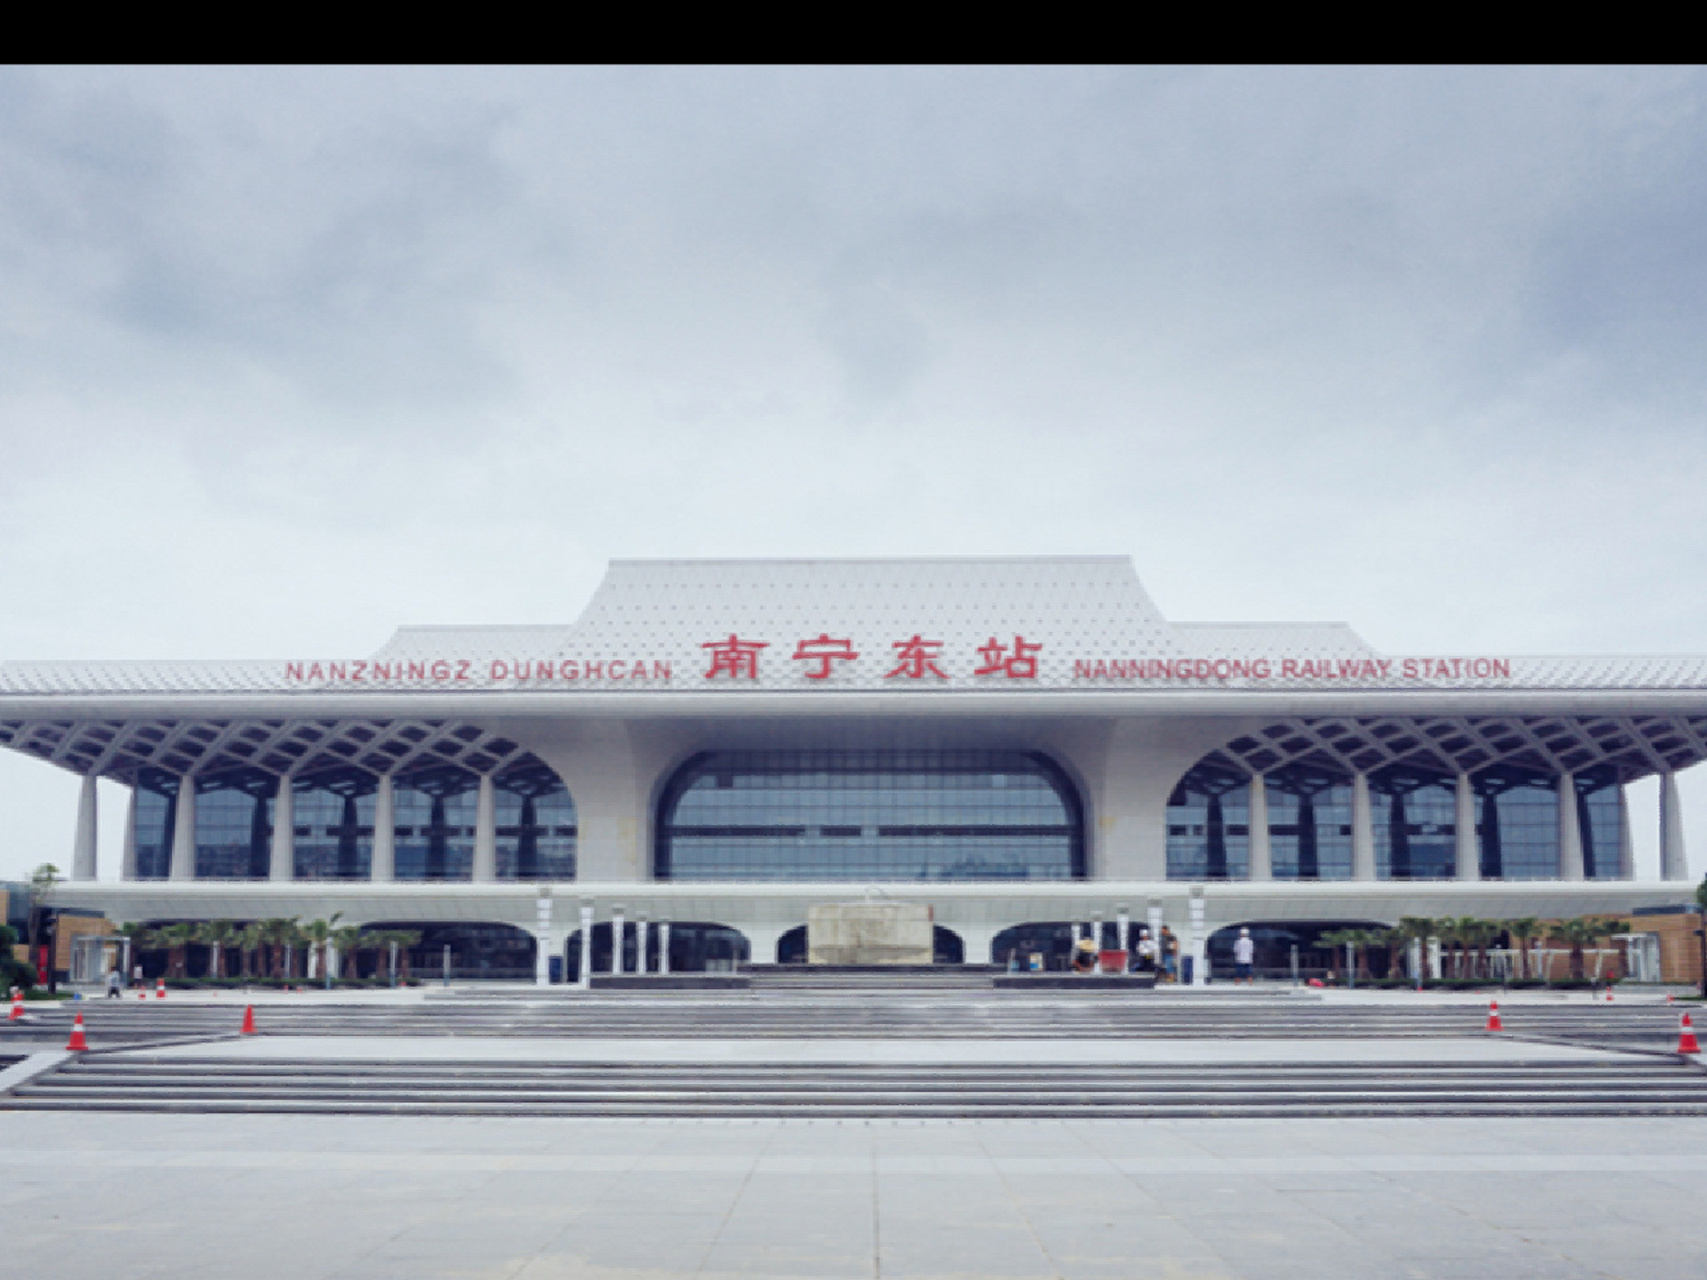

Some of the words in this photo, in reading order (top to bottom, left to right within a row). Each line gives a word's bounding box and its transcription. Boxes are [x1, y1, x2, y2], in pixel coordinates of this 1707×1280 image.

[700, 633, 1043, 680] 南宁东站
[285, 660, 471, 680] NANZNINGZ
[491, 660, 672, 680] DUNGHCAN
[1074, 658, 1271, 679] NANNINGDONG
[1281, 658, 1392, 679] RAILWAY
[1402, 658, 1510, 679] STATION
